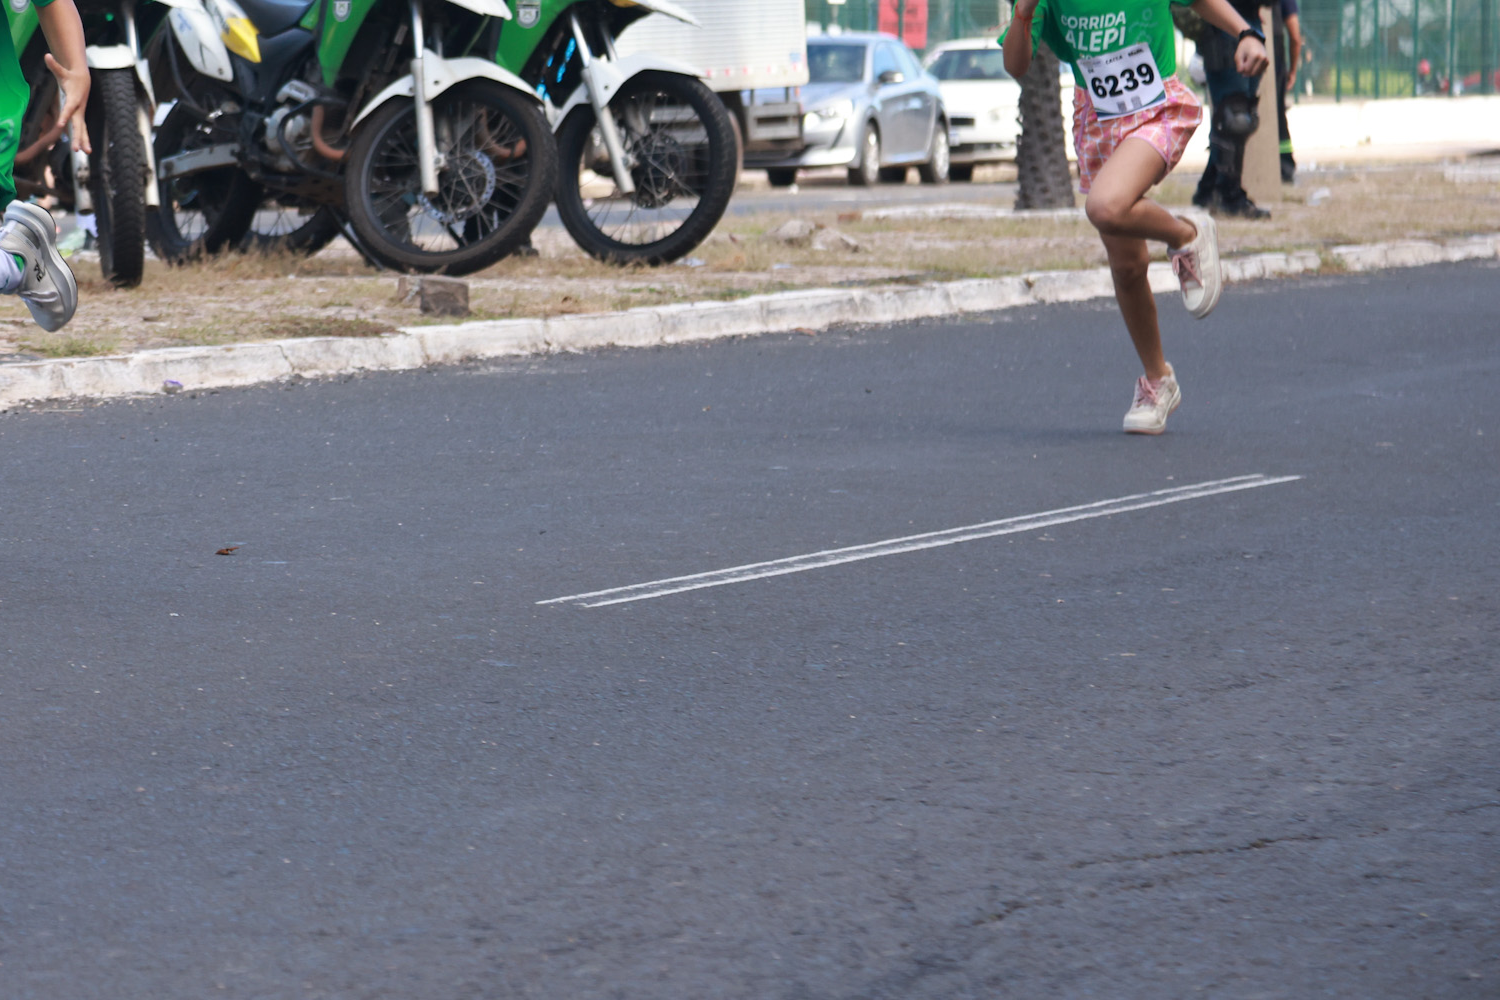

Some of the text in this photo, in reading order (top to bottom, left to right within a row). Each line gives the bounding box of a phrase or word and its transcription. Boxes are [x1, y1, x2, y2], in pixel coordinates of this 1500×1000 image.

[1060, 10, 1126, 30] CORRIDA
[1065, 26, 1127, 52] ALEPI
[1091, 63, 1155, 99] 6239
